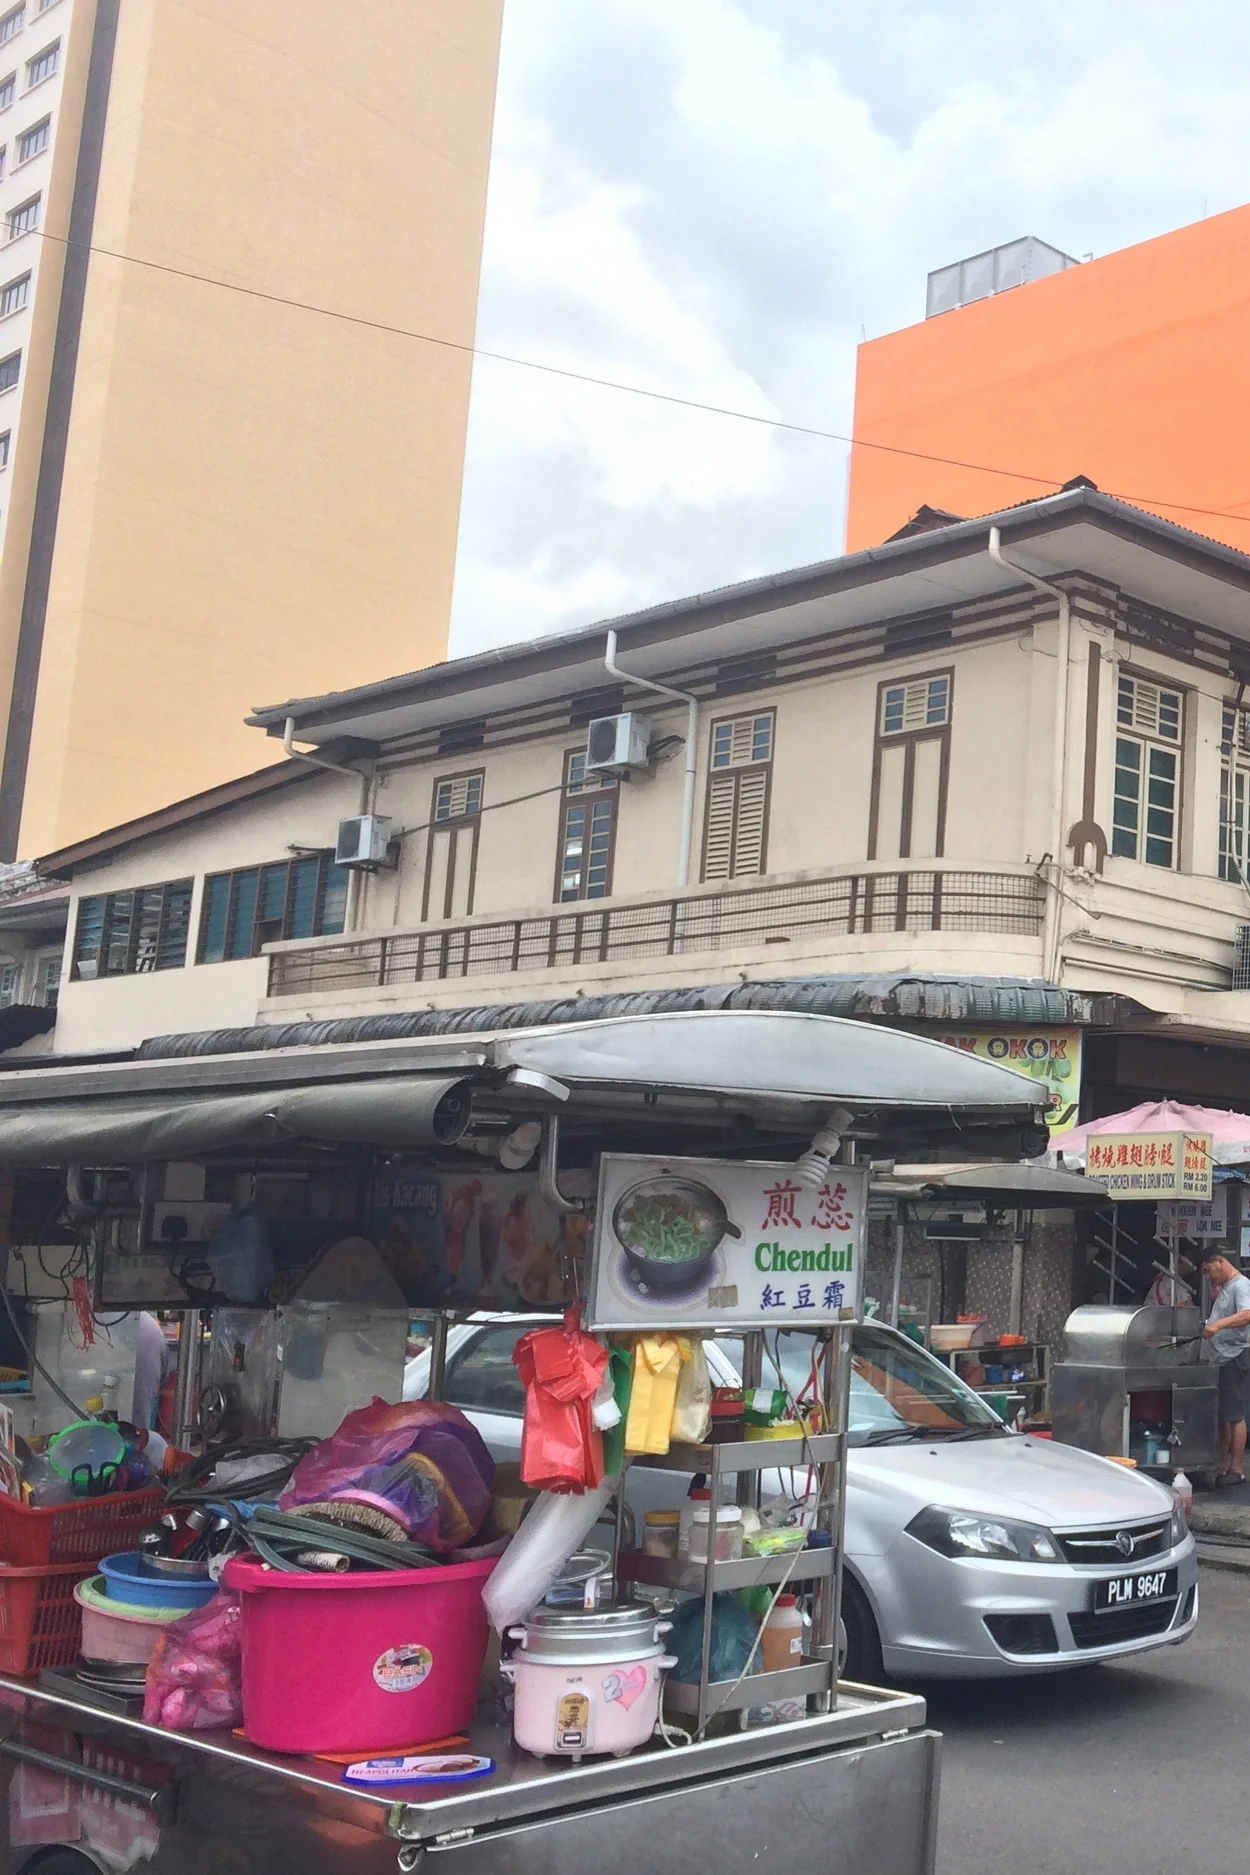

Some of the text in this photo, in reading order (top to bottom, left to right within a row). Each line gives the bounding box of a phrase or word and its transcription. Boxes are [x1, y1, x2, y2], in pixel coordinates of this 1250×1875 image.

[987, 1037, 1067, 1059] OKOK
[1110, 1173, 1130, 1190] CHICKEN
[1161, 1172, 1176, 1189] STICK
[1183, 1172, 1193, 1181] RM
[1195, 1172, 1208, 1182] 2.20
[1183, 1182, 1208, 1192] RM 6.00
[1196, 1220, 1223, 1232] LOR MEE
[754, 1241, 854, 1272] Chendul
[760, 1280, 846, 1311] 紅豆霜
[1108, 1577, 1133, 1604] PLM
[1137, 1572, 1167, 1598] 9647
[381, 1664, 423, 1678] BASIN
